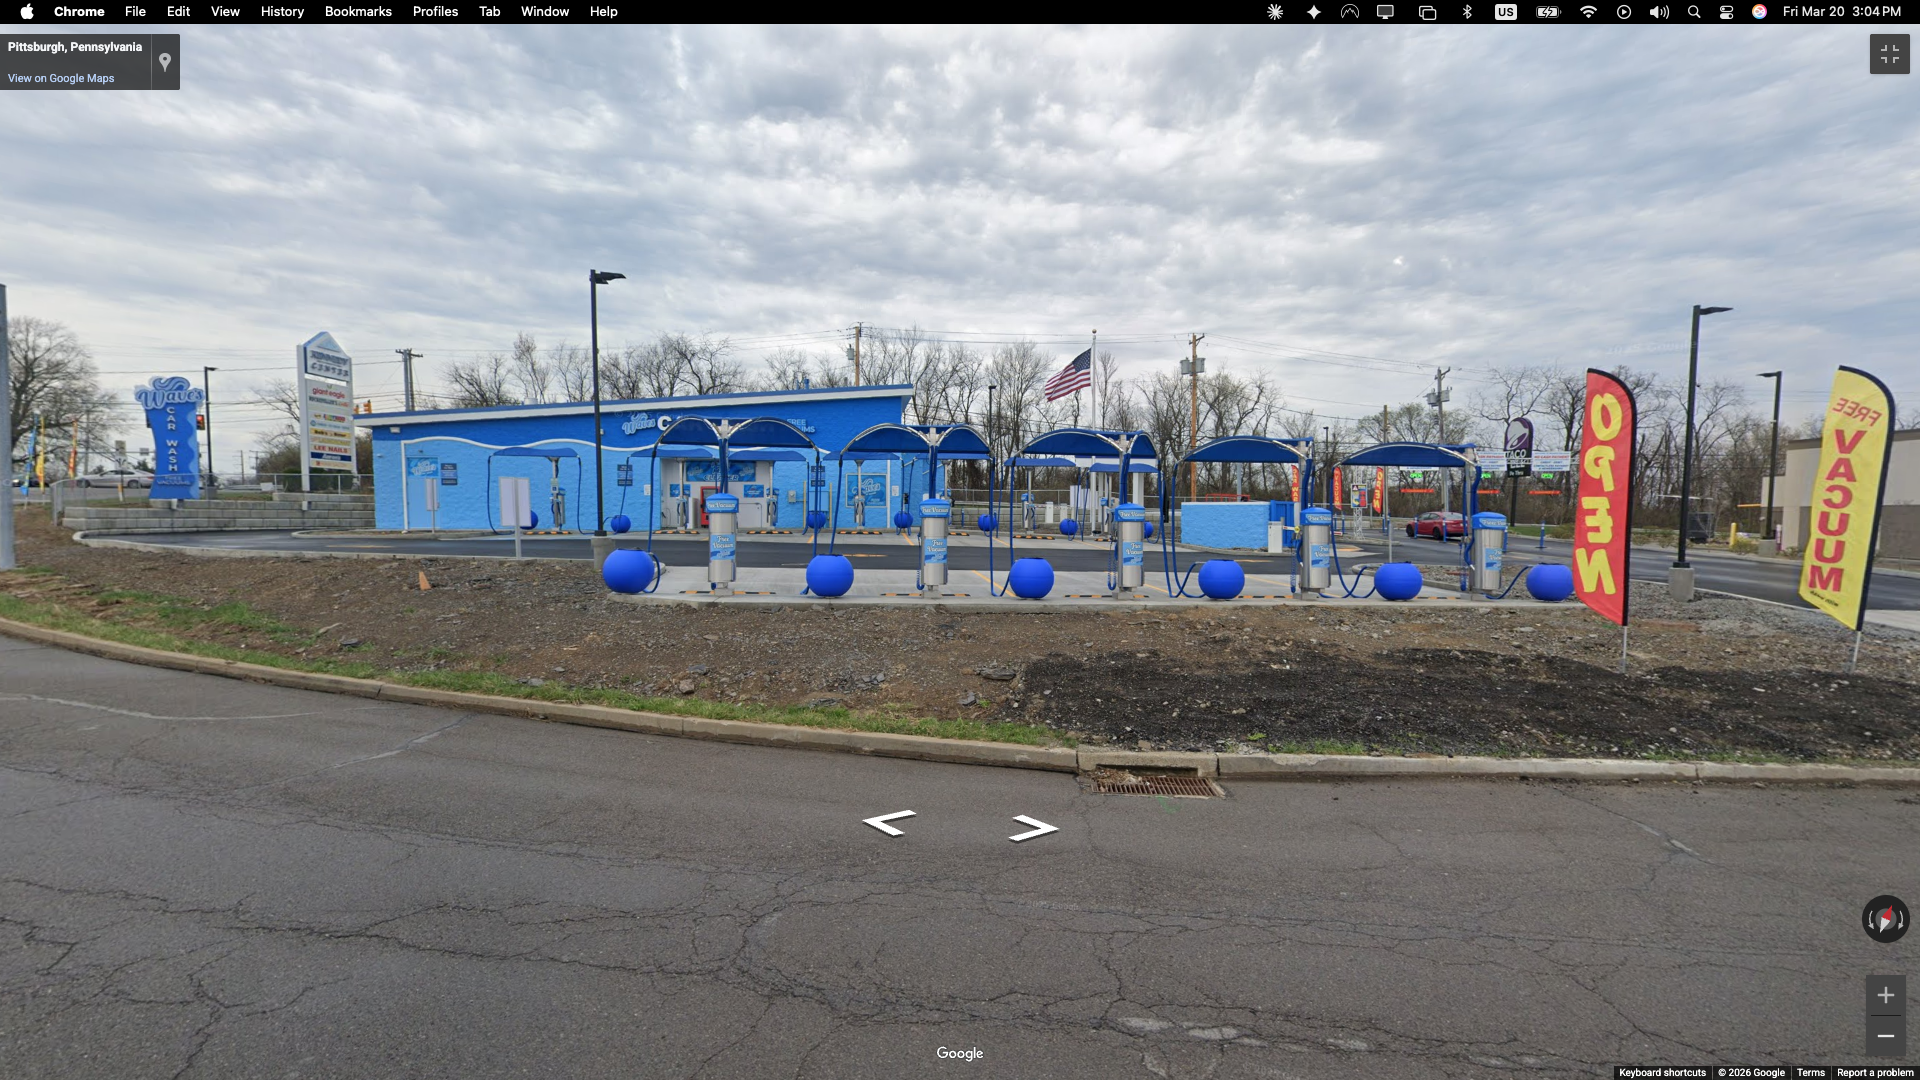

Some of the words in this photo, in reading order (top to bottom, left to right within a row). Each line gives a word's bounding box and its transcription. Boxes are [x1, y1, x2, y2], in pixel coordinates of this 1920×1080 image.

[312, 387, 328, 396] giant
[135, 387, 205, 409] Wave's
[166, 406, 176, 430] CAR
[166, 440, 178, 472] WASH
[1505, 448, 1527, 459] TACO
[717, 535, 730, 543] Free
[932, 539, 943, 547] Free
